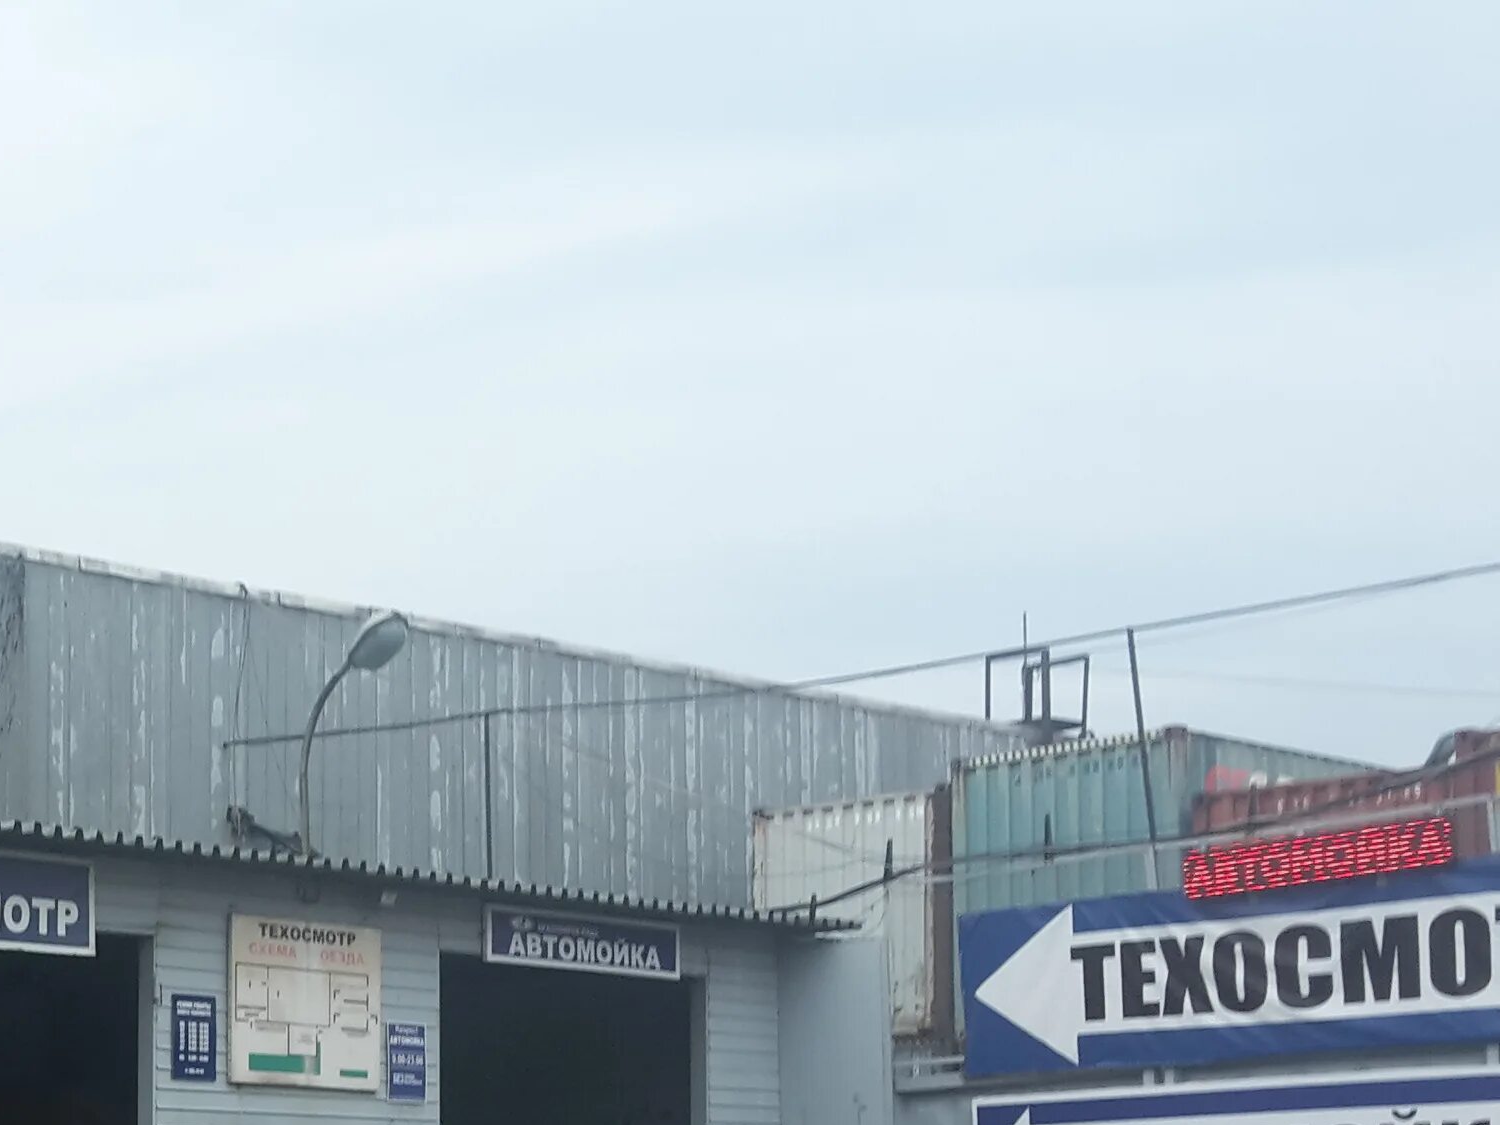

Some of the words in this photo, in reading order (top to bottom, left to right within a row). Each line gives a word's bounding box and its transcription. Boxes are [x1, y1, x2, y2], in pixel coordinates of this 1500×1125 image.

[258, 922, 356, 946] ТЕХОСМОТР
[508, 931, 661, 971] АВТОМОЙКА
[1070, 905, 1500, 1022] ТЕХОСМО
